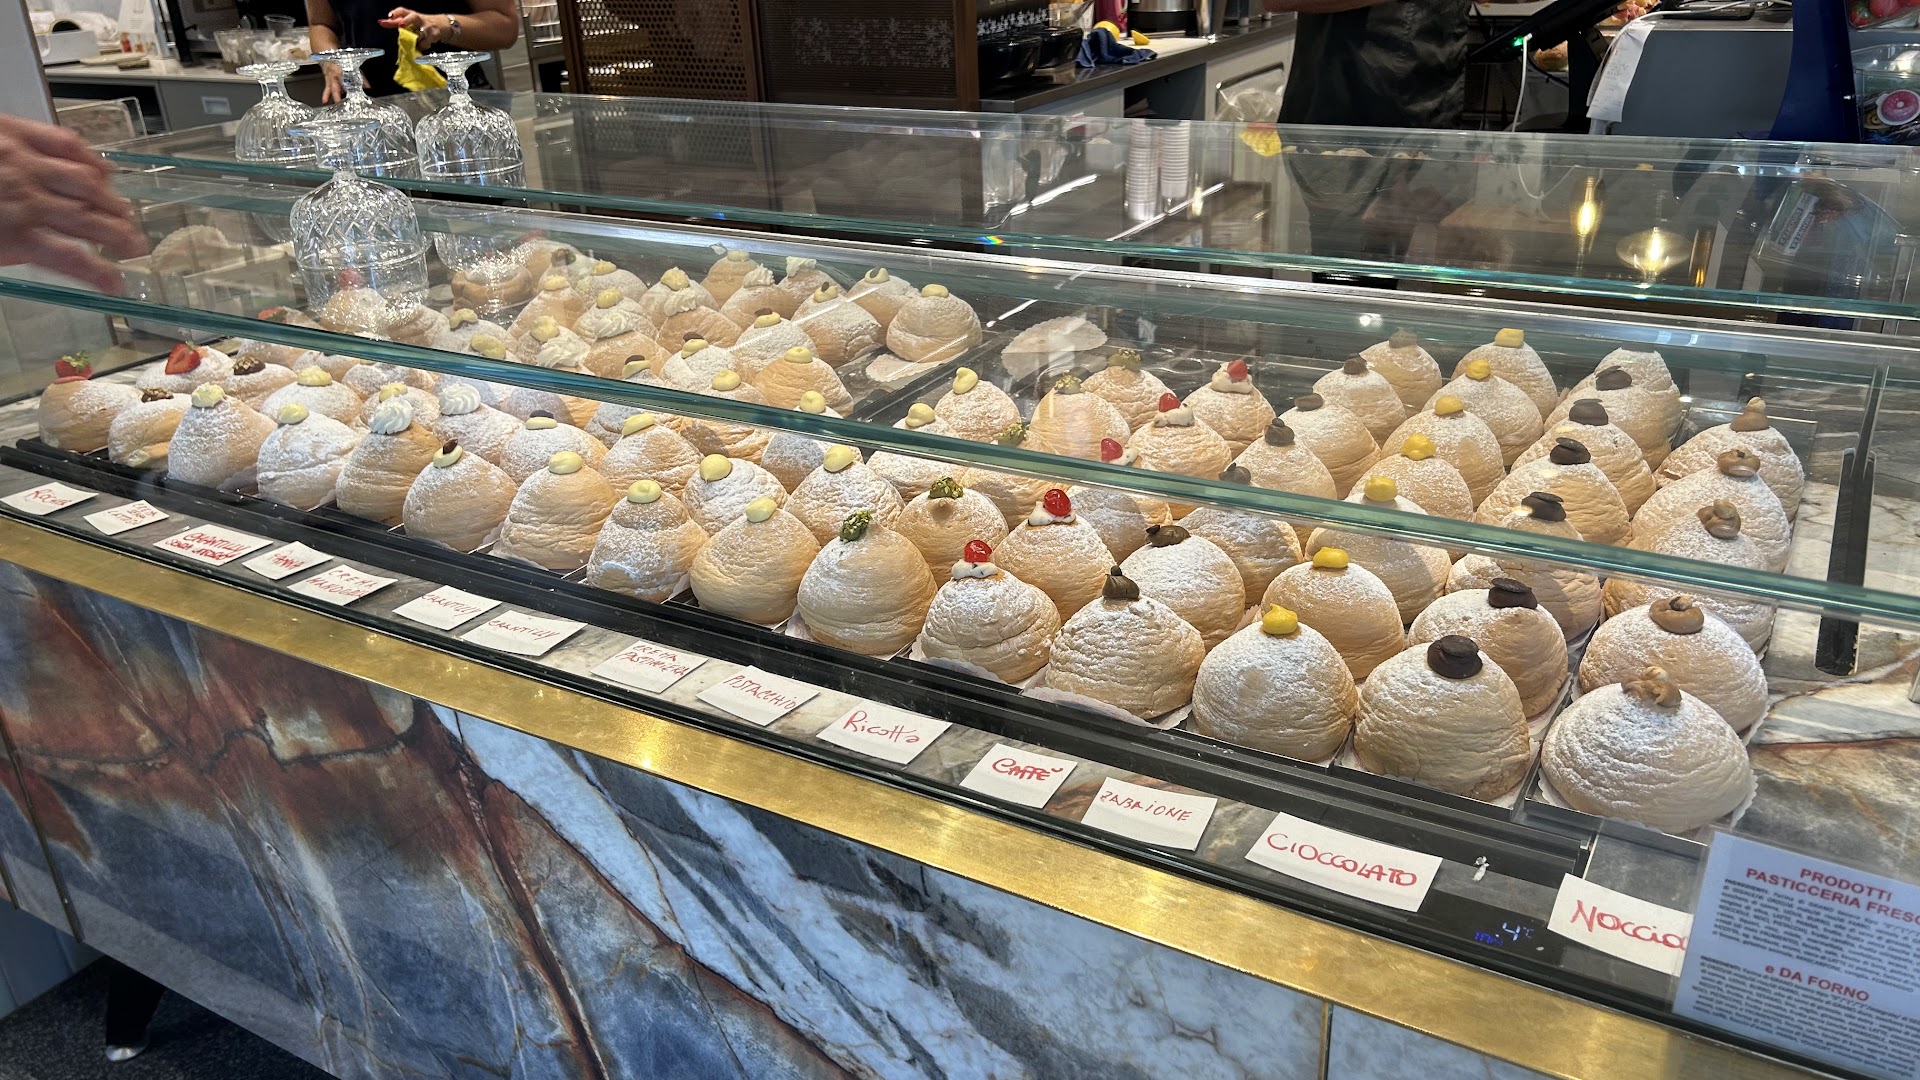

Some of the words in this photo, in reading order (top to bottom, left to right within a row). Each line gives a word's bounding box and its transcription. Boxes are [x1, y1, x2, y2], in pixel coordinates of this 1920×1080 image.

[328, 570, 378, 589] CREMA
[421, 594, 481, 617] CHANTILLY
[488, 620, 561, 641] CHANTILLY
[633, 645, 677, 662] CREMA
[723, 674, 797, 710] PISTACCHIO
[1100, 790, 1193, 823] ZABAIONE
[1266, 832, 1418, 887] CIOCCOLATO
[1746, 868, 1861, 909] PASTICCERIA
[1800, 868, 1893, 902] PRODOTTI
[1765, 964, 1775, 974] e
[1780, 968, 1802, 983] DA
[1807, 976, 1870, 1002] FORNO
